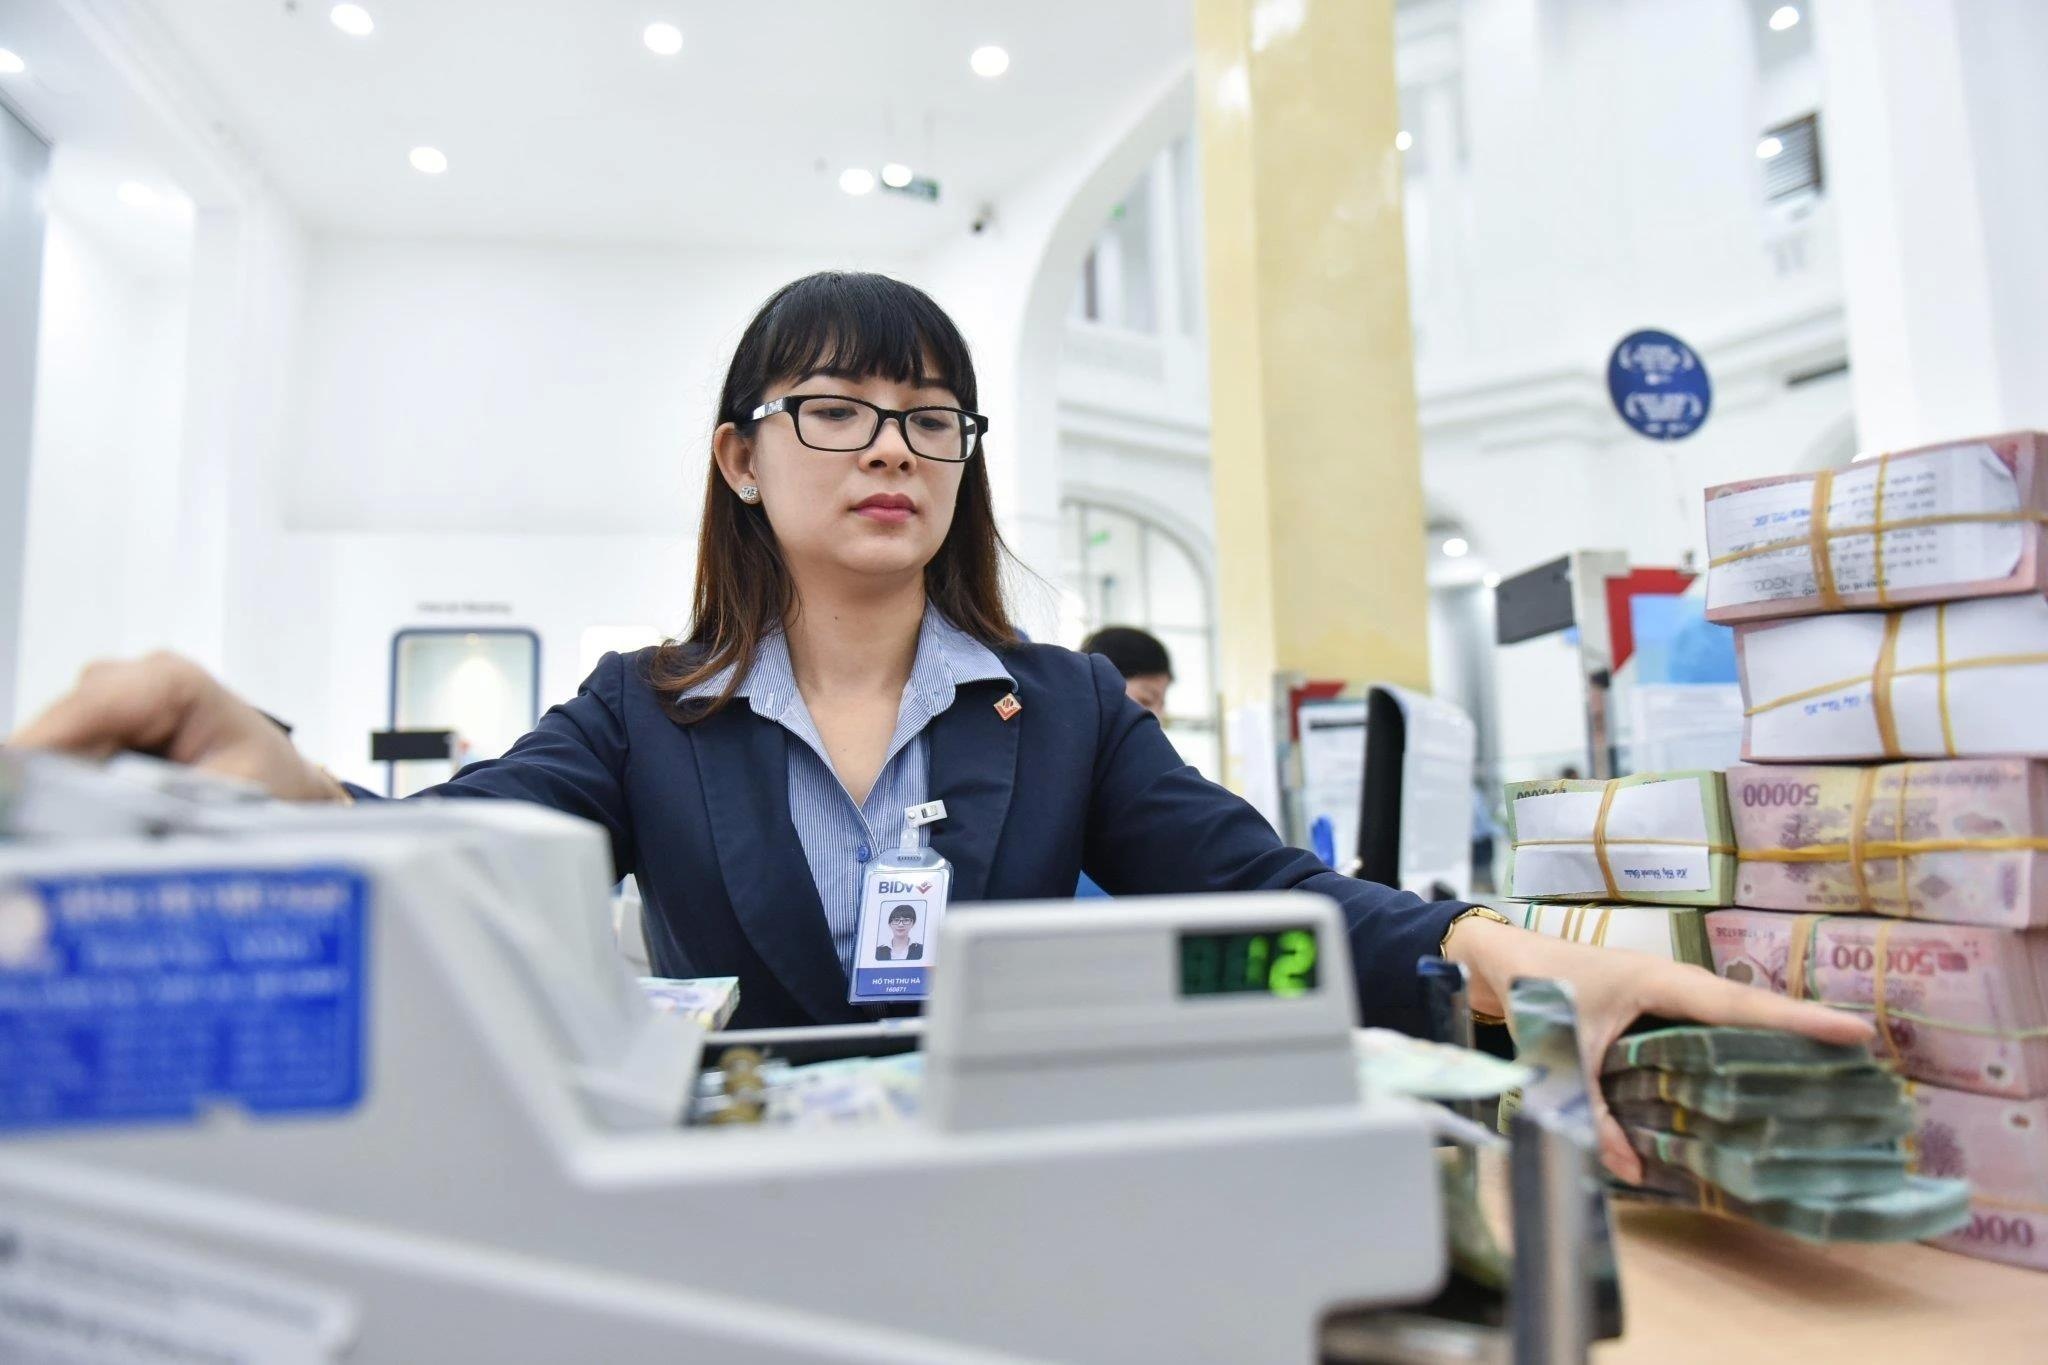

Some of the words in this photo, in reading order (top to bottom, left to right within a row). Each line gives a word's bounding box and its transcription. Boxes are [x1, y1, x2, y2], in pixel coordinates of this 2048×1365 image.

[1743, 783, 1820, 807] 50000
[1247, 929, 1318, 999] 12
[910, 976, 921, 984] HÀ
